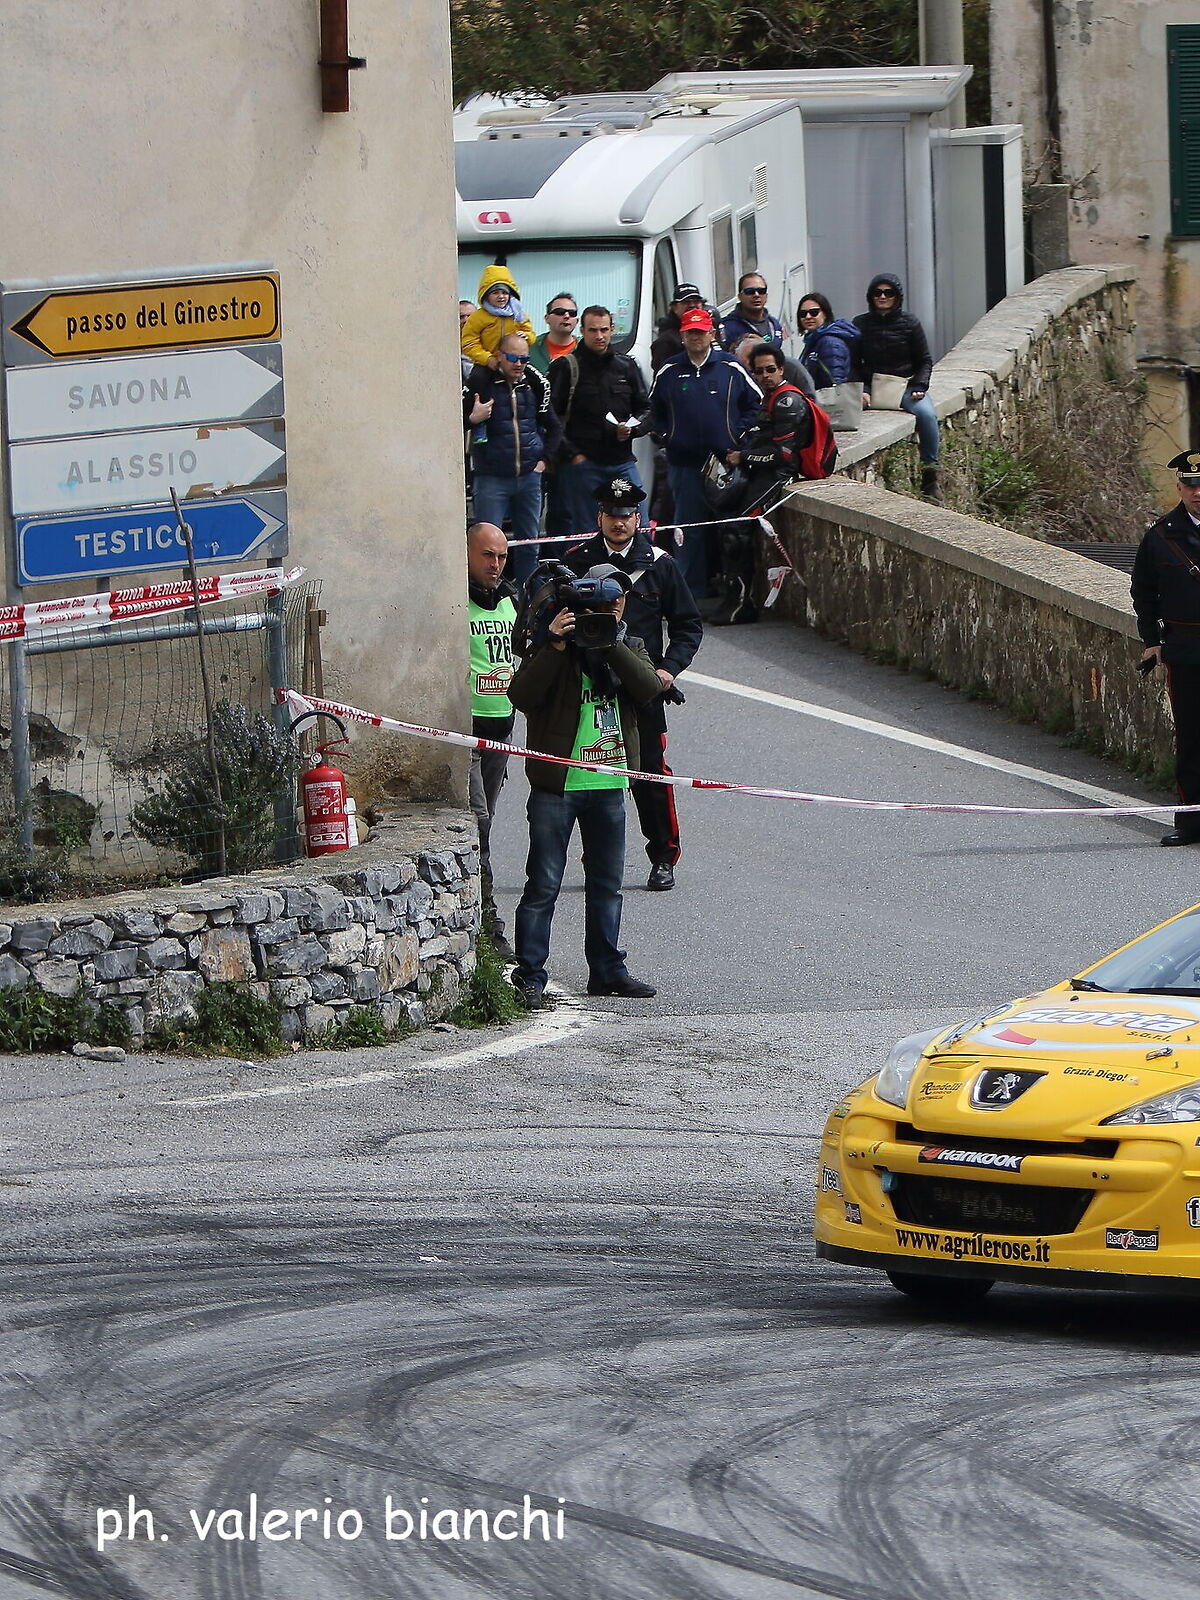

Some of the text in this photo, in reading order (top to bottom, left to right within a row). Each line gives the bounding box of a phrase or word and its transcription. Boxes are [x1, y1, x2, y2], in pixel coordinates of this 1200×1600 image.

[67, 297, 261, 341] passo del Ginestro
[68, 375, 192, 410] SAVONA
[66, 449, 197, 485] ALASSIO
[74, 522, 194, 558] TESTICO
[115, 586, 145, 603] ZONA
[470, 620, 514, 635] MEDIA
[485, 636, 512, 664] 126
[480, 678, 502, 690] RALLYE
[584, 750, 606, 762] RALLYE
[310, 832, 345, 842] CEA
[1063, 1066, 1129, 1082] Grazie Diego!
[895, 1229, 1050, 1263] www.agrilerose.it
